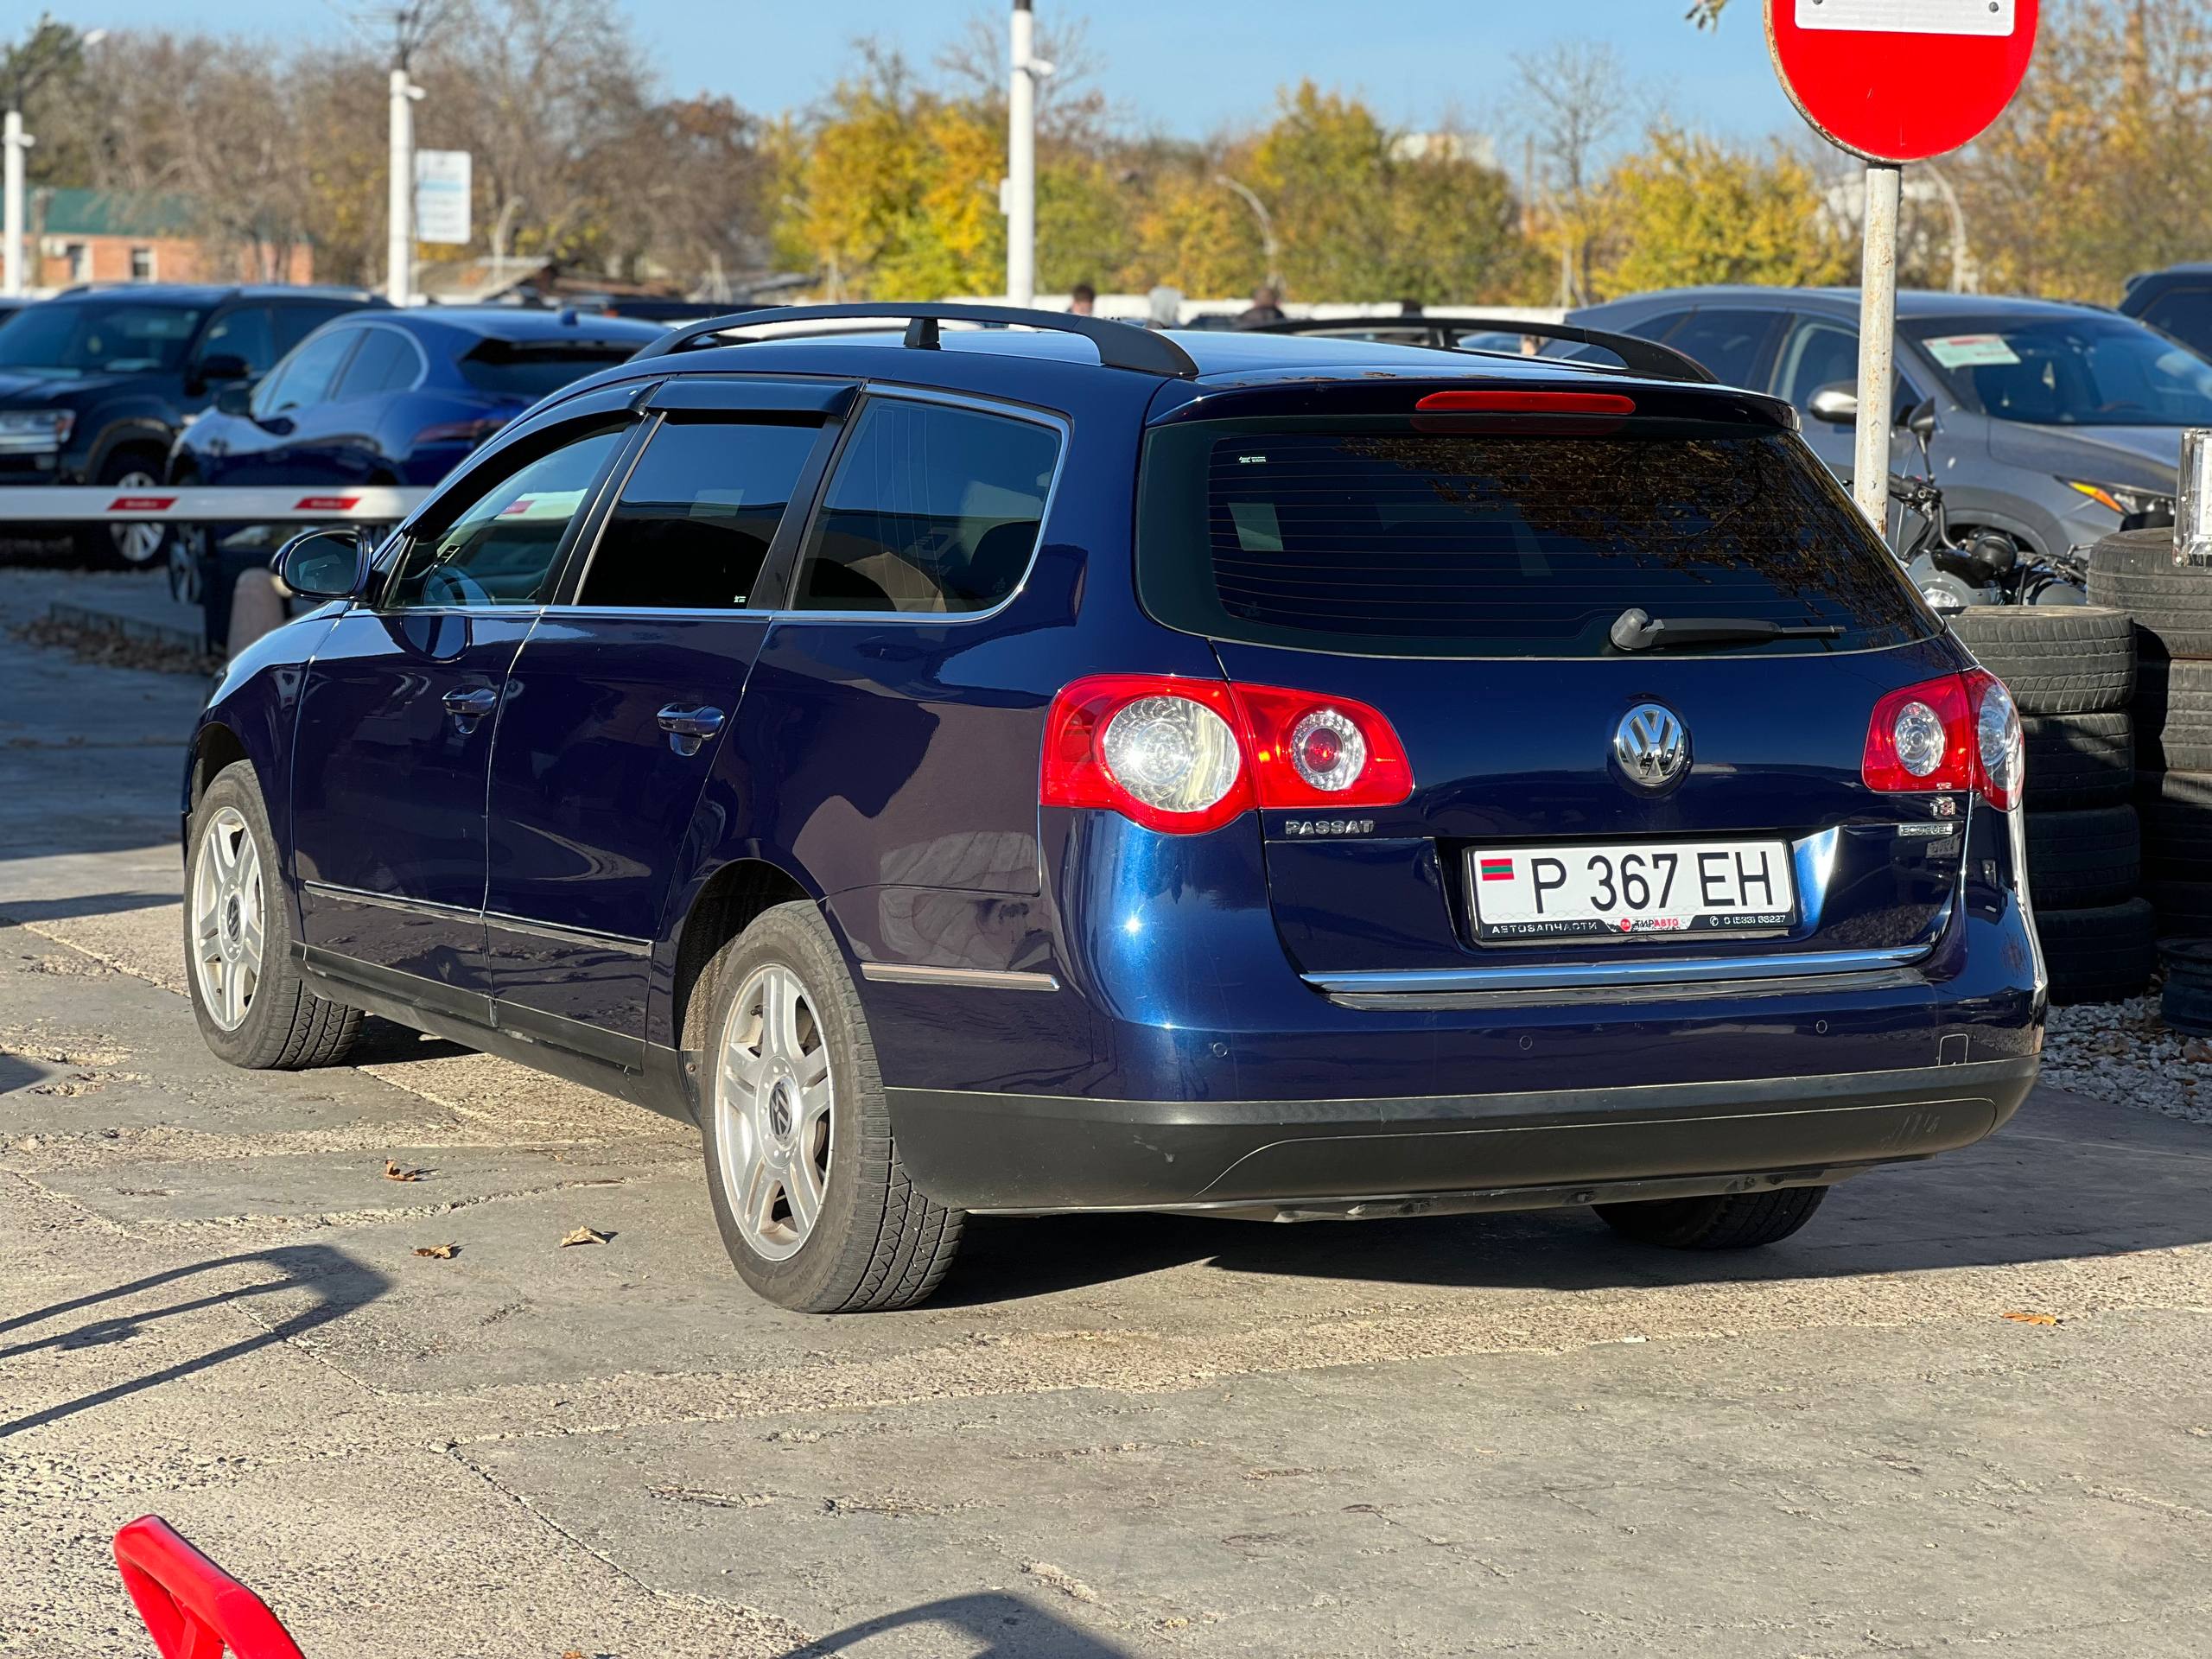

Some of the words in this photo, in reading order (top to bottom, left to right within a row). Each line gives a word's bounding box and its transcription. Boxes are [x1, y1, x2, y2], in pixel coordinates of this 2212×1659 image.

[1285, 820, 1376, 835] PASSAT
[1530, 857, 1567, 914] P
[1586, 853, 1679, 912] 367
[1696, 851, 1773, 907] EH
[1491, 921, 1598, 934] АВТОЗАПЧАСТИ
